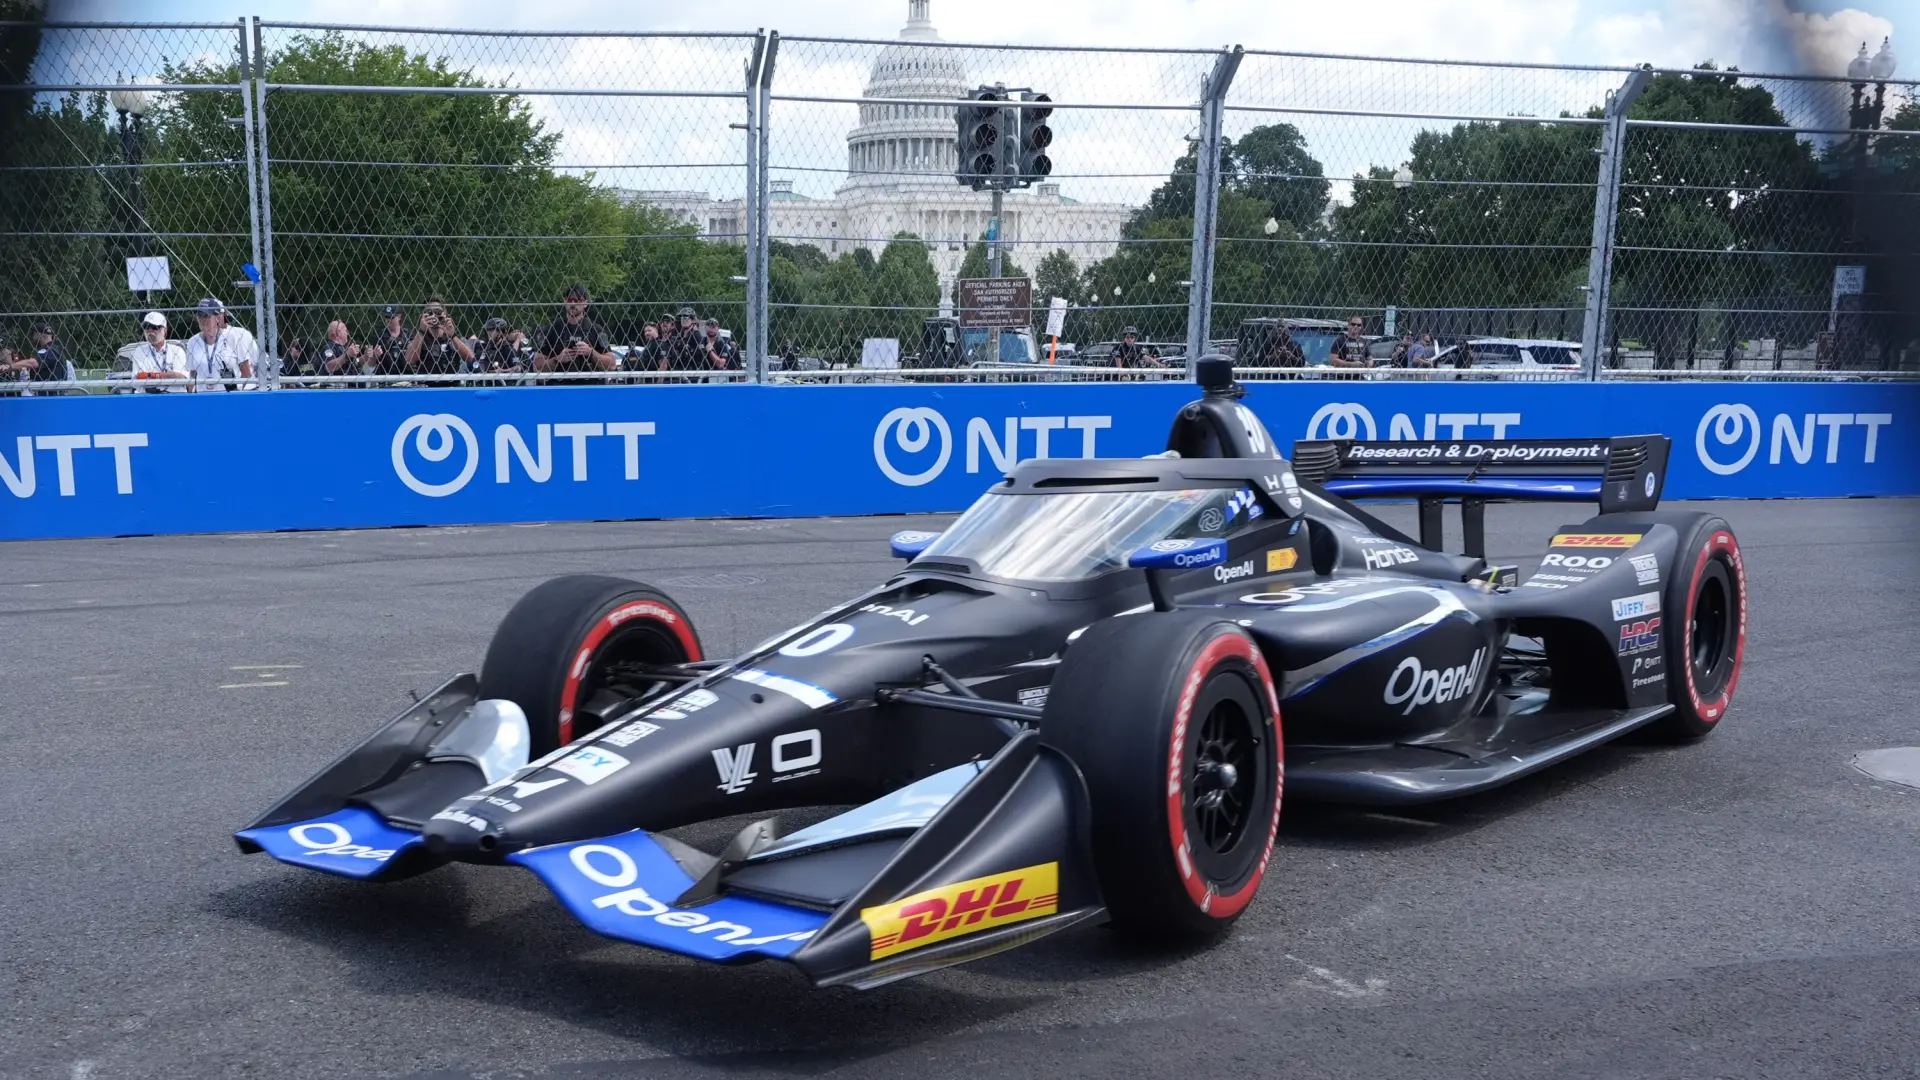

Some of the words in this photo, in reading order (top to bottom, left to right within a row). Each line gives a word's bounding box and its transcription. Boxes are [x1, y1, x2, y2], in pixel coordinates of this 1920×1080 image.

[966, 415, 1112, 473] NTT
[1234, 406, 1266, 454] 10
[1769, 412, 1893, 465] NTT
[495, 421, 656, 484] NTT
[1348, 444, 1440, 458] Research
[1444, 444, 1461, 457] &
[1174, 547, 1220, 567] OpenAI
[1361, 546, 1420, 571] Honda
[1562, 536, 1626, 546] DHL
[1213, 560, 1254, 583] OpenAI
[1540, 553, 1621, 569] ROO
[1616, 600, 1644, 617] JIFFY
[1618, 616, 1662, 652] HRC
[1383, 646, 1487, 715] OpenAI
[1632, 672, 1665, 689] Firestone
[1168, 669, 1203, 797] Firestone
[288, 823, 397, 861] Ope
[896, 878, 1031, 944] DHL
